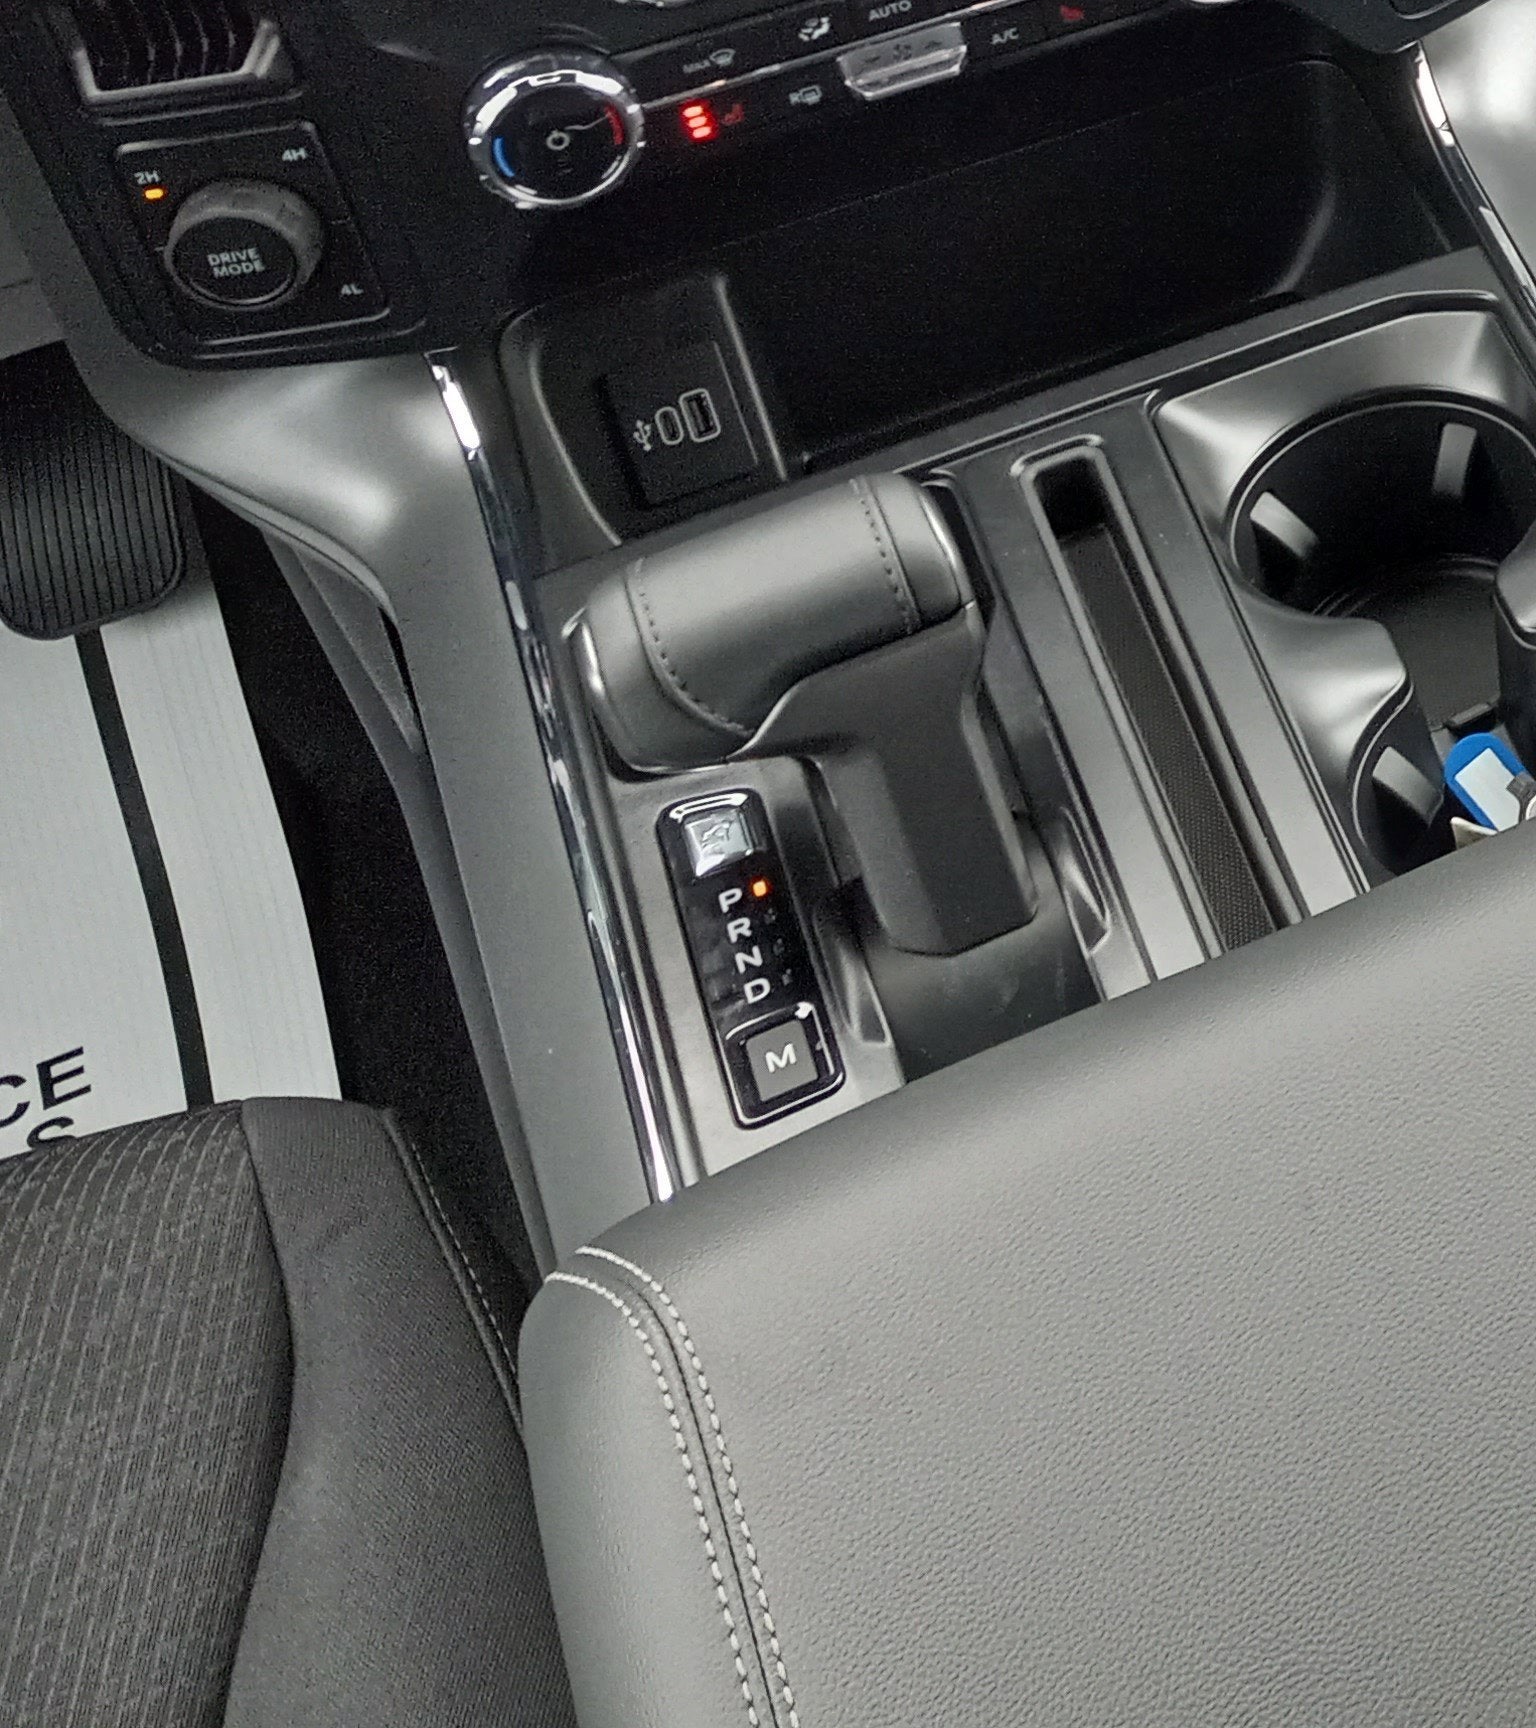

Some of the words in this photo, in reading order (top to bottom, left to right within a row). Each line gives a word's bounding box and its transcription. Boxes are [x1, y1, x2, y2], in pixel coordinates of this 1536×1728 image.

[991, 26, 1020, 46] A/C
[281, 147, 311, 163] 4H
[133, 169, 162, 186] 2H
[207, 246, 262, 267] DRIVE
[212, 258, 267, 280] MODE
[340, 283, 364, 297] 4L
[717, 887, 744, 914] P
[726, 916, 753, 944] R
[734, 944, 764, 974] N
[742, 977, 772, 1005] D
[764, 1042, 798, 1073] M
